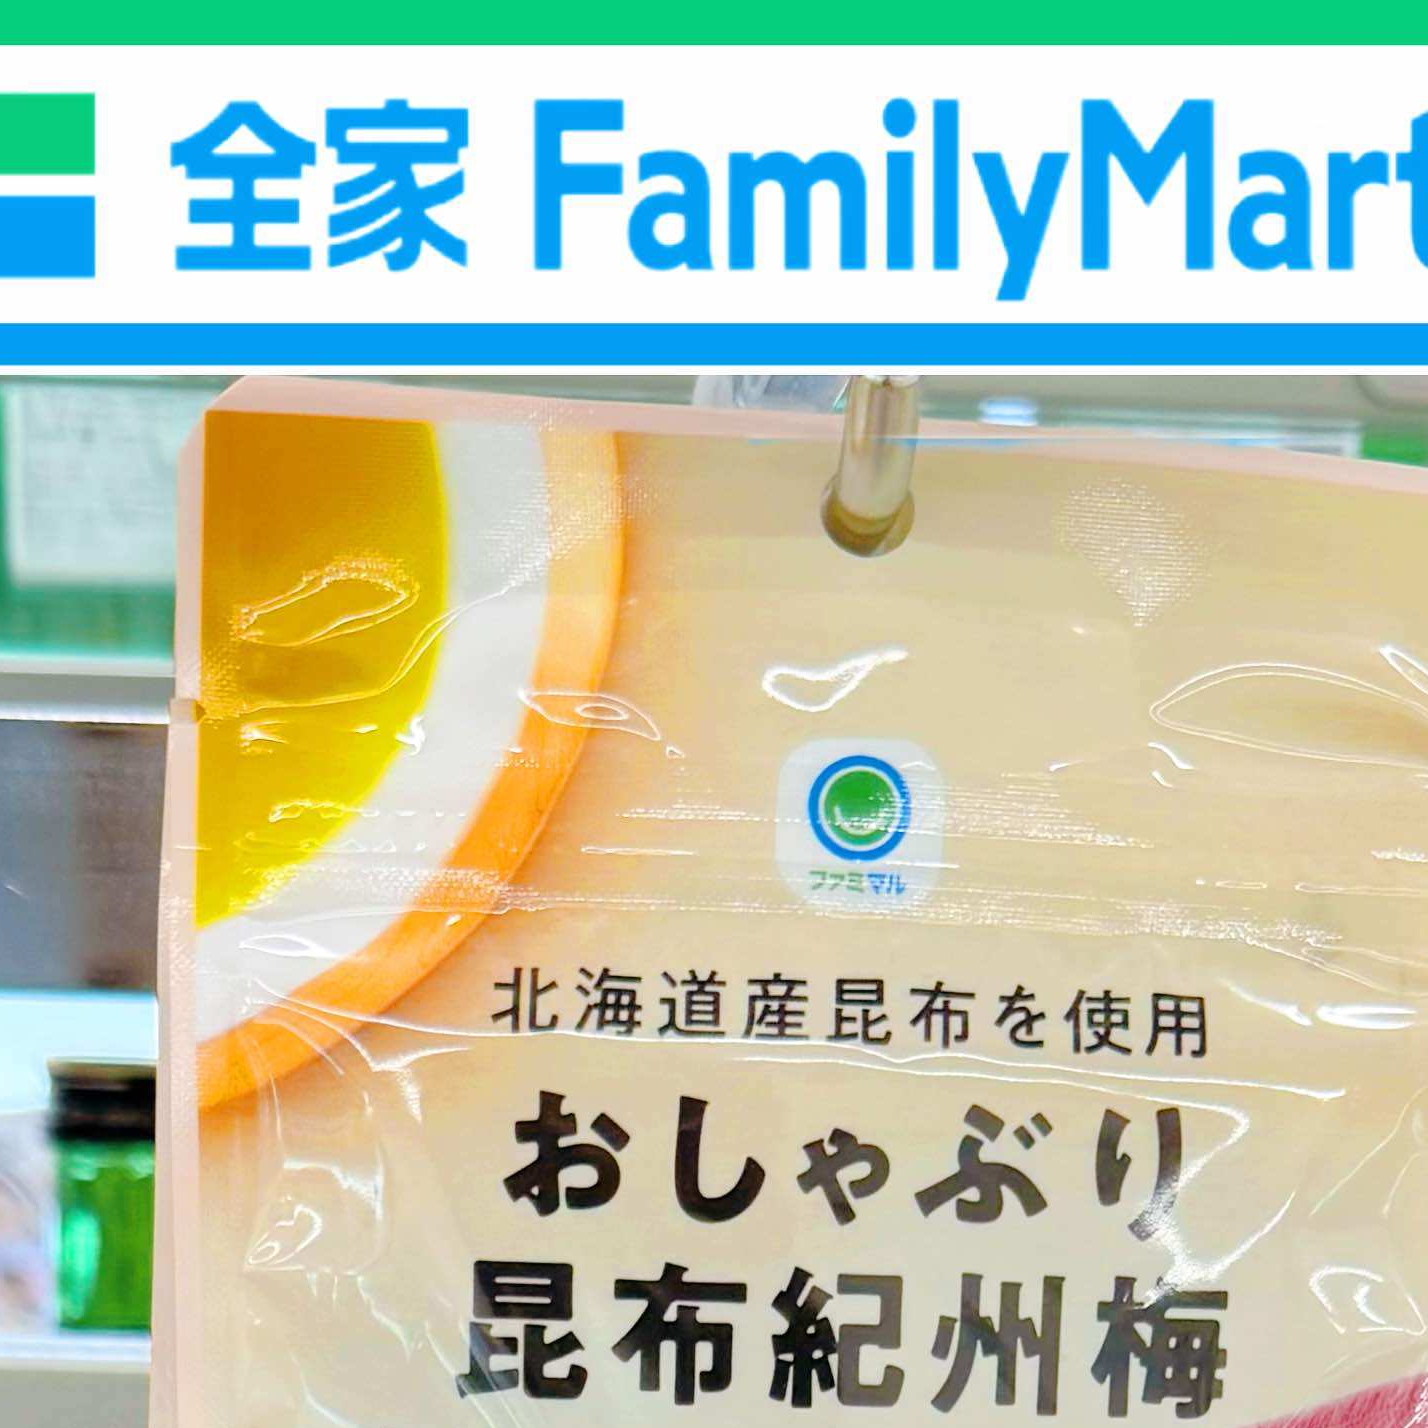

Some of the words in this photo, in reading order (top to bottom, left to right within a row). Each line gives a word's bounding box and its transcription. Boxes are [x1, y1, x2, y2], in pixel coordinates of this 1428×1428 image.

[808, 869, 905, 896] ファミマル
[491, 964, 1212, 1061] 北海道産昆布を使用
[501, 1089, 1185, 1240] おしゃぶり
[458, 1257, 1228, 1420] 昆布紀州梅
